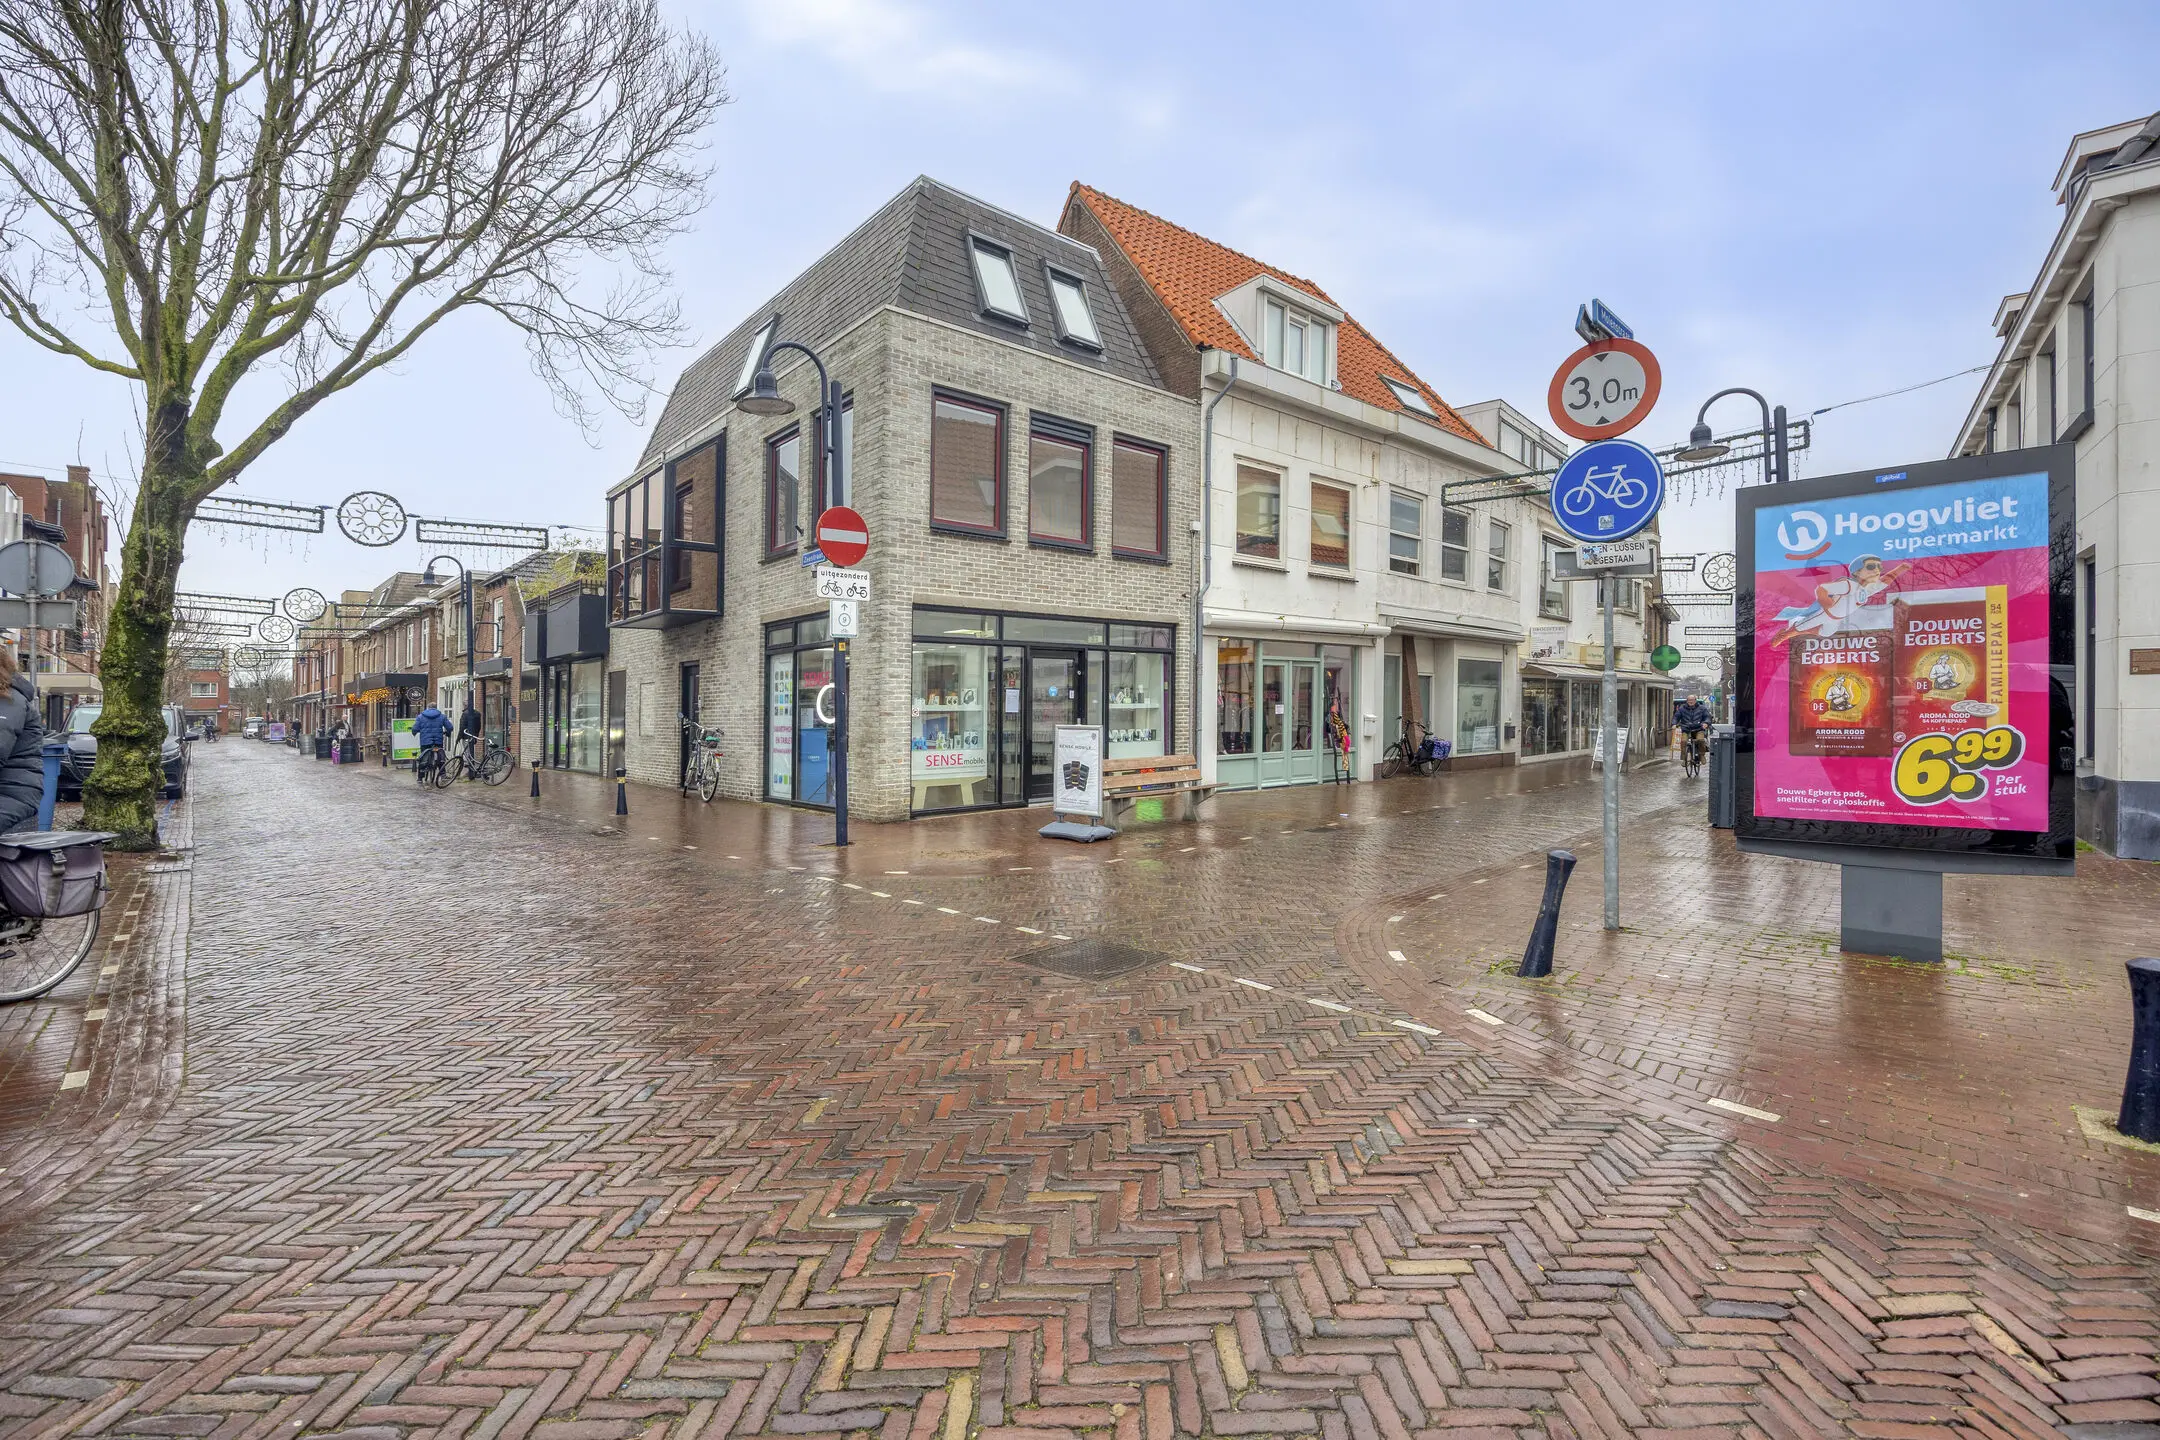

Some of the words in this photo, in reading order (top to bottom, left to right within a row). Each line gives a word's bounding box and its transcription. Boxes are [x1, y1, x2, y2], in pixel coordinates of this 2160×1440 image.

[1568, 377, 1638, 410] 3,0m
[1835, 496, 2018, 535] Hoogvliet
[1883, 524, 2018, 552] supermarkt
[1614, 542, 1645, 552] LOSSEN
[1584, 554, 1634, 566] EGESTAAN
[821, 571, 868, 580] uitgezonderd
[1904, 632, 1986, 646] EGBERTS
[1801, 650, 1880, 665] EGBERTS
[1990, 622, 2003, 704] FAMILIEPAK
[925, 753, 963, 767] SENSE
[1995, 774, 2021, 785] Per
[1777, 787, 1806, 795] Douwe
[1808, 788, 1841, 797] Egberts
[1843, 790, 1867, 798] pads,
[1994, 783, 2027, 796] stuk
[1776, 796, 1820, 804] snelfilter-
[1833, 798, 1885, 807] oploskoffie
